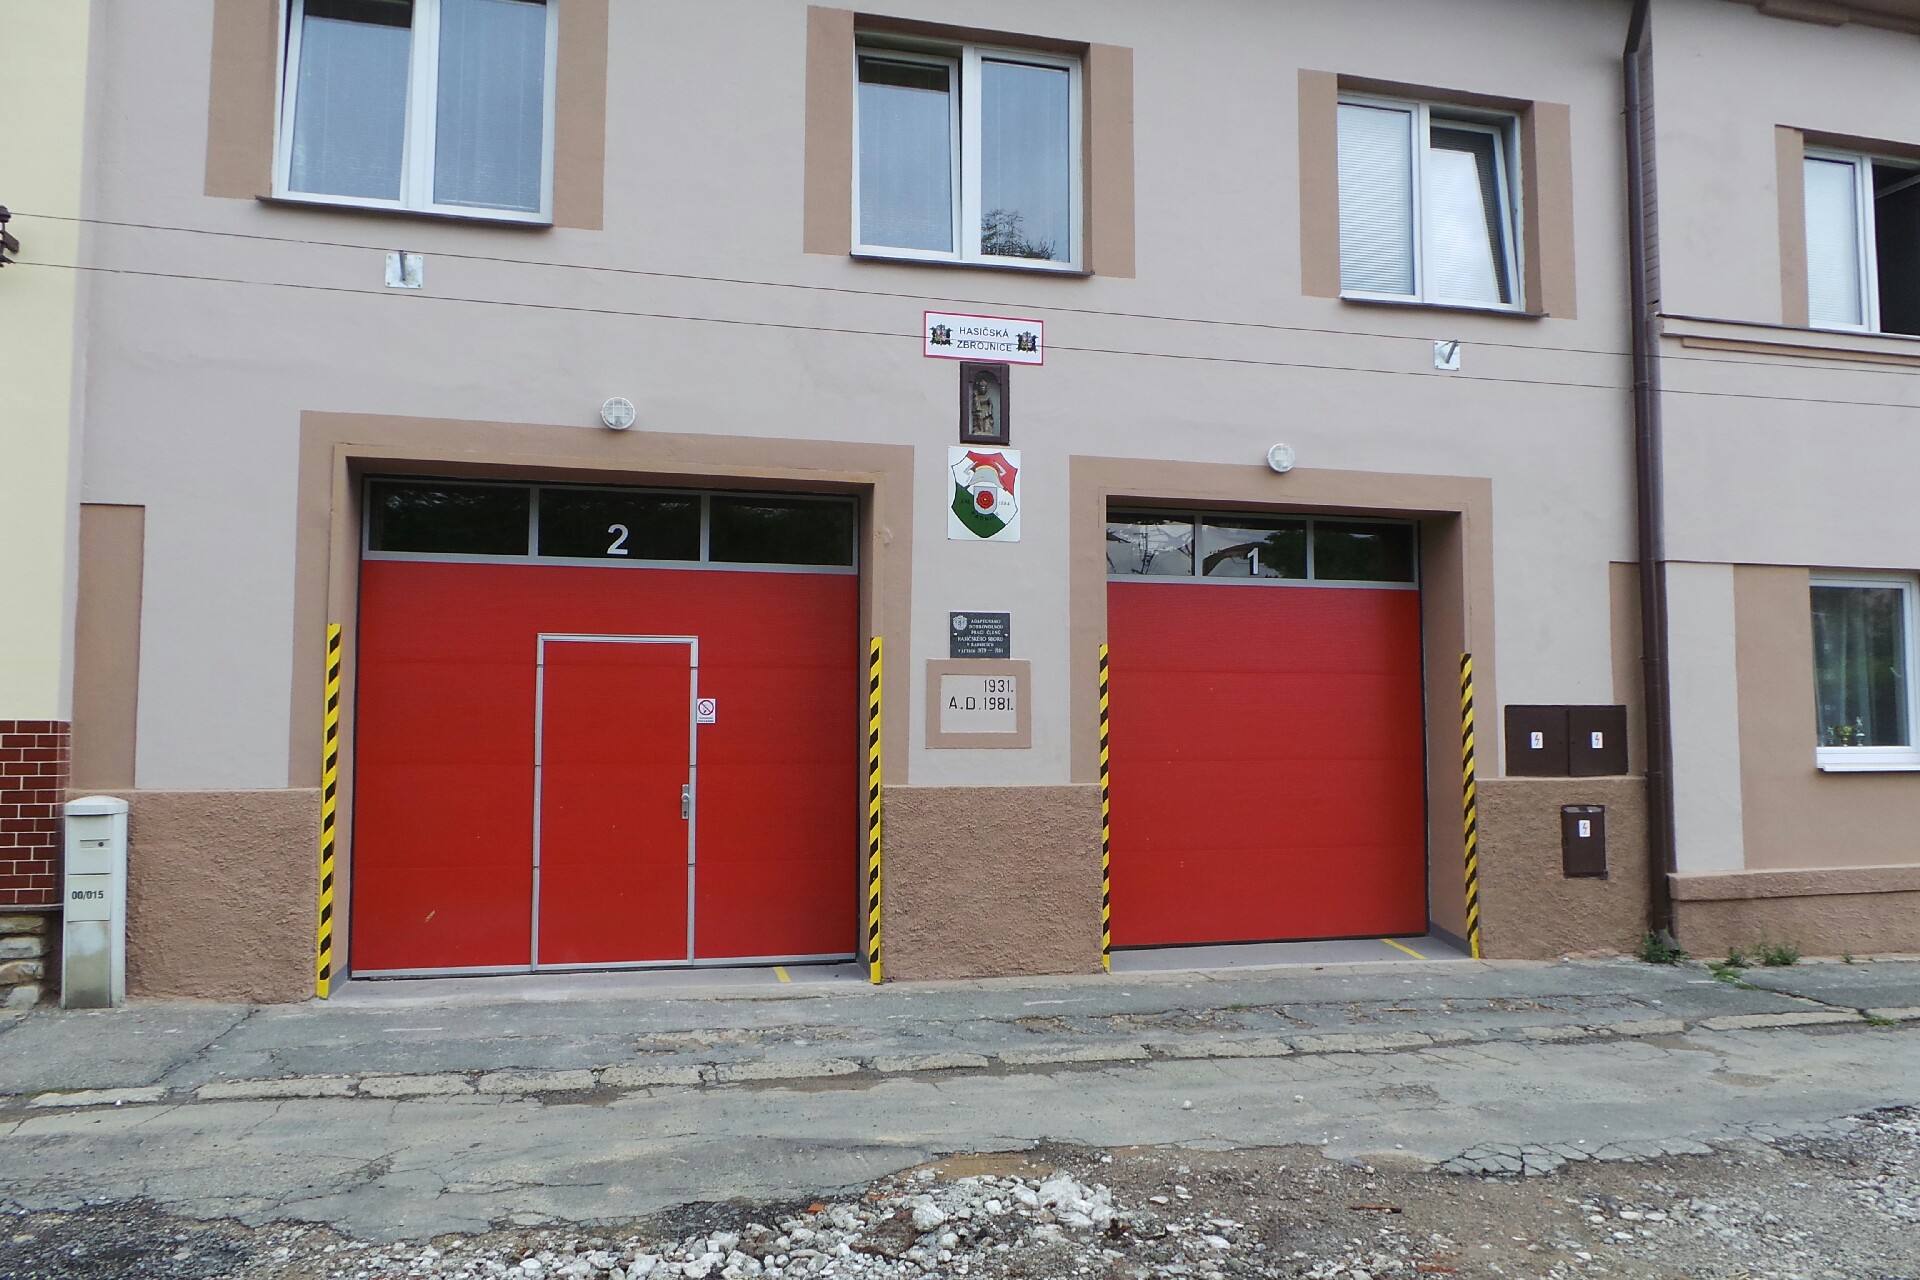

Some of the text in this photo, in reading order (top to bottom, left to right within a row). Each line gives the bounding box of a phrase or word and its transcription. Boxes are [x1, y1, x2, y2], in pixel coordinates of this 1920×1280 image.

[959, 327, 1009, 338] HASIČSKÁ
[957, 340, 1012, 352] ZBROJNICE
[607, 524, 628, 555] 2
[1247, 547, 1259, 575] 1
[984, 679, 1014, 693] 1931.
[71, 891, 104, 901] 00/015
